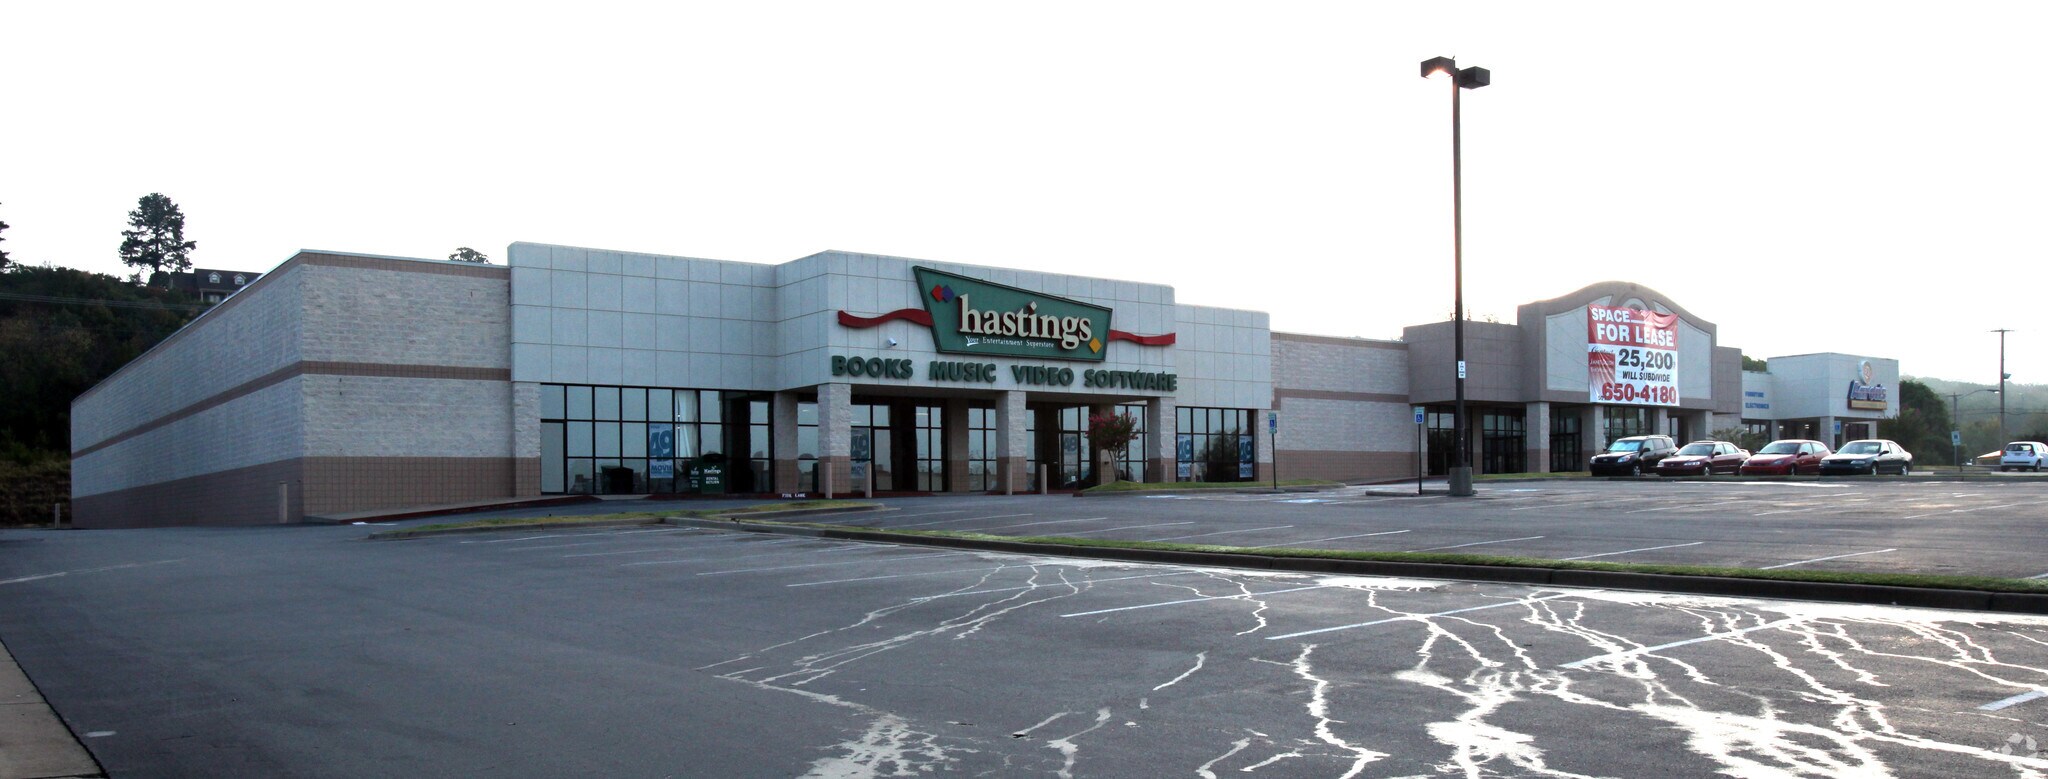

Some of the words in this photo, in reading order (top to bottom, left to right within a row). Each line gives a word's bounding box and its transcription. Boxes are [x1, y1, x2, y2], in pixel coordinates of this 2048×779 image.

[959, 294, 1092, 350] hastings
[1591, 307, 1630, 323] SPACE
[982, 337, 1023, 346] Entertainment
[1026, 340, 1055, 348] Superstore
[1596, 323, 1630, 342] FOR
[1635, 325, 1675, 347] LEASE
[1618, 348, 1673, 371] 25,200
[831, 356, 913, 379] BOOKS
[929, 361, 997, 383] MUSIC
[1011, 365, 1075, 387] VIDEO
[1084, 369, 1178, 392] SOFTWARE
[1622, 371, 1638, 380] WILL
[1639, 372, 1671, 382] SUBDIVIDE
[1602, 382, 1676, 404] 650-4180
